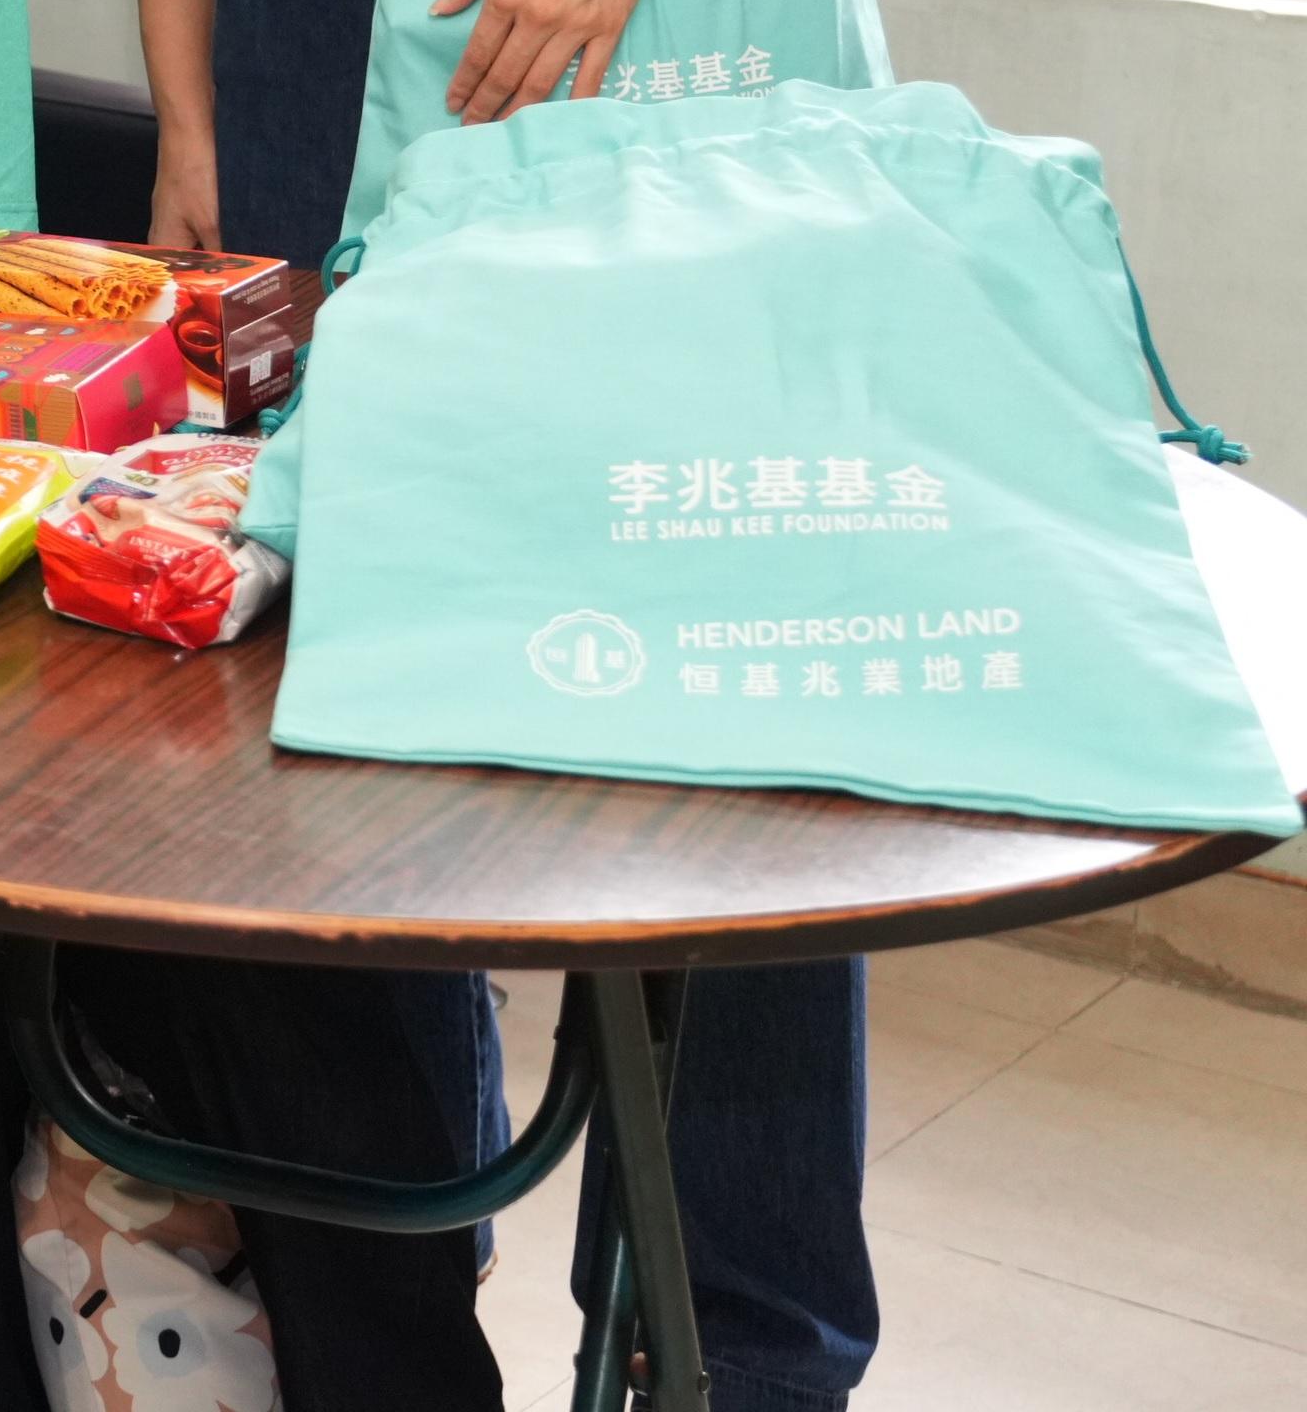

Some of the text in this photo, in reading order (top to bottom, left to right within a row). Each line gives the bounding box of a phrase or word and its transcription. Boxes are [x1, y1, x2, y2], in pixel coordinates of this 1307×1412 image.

[608, 455, 949, 514] 李兆基基金
[611, 512, 950, 542] LEE SHAU KEE FOUNDATION
[677, 607, 1021, 650] HENDERSON LAND
[678, 650, 1025, 698] 恒基兆業地產
